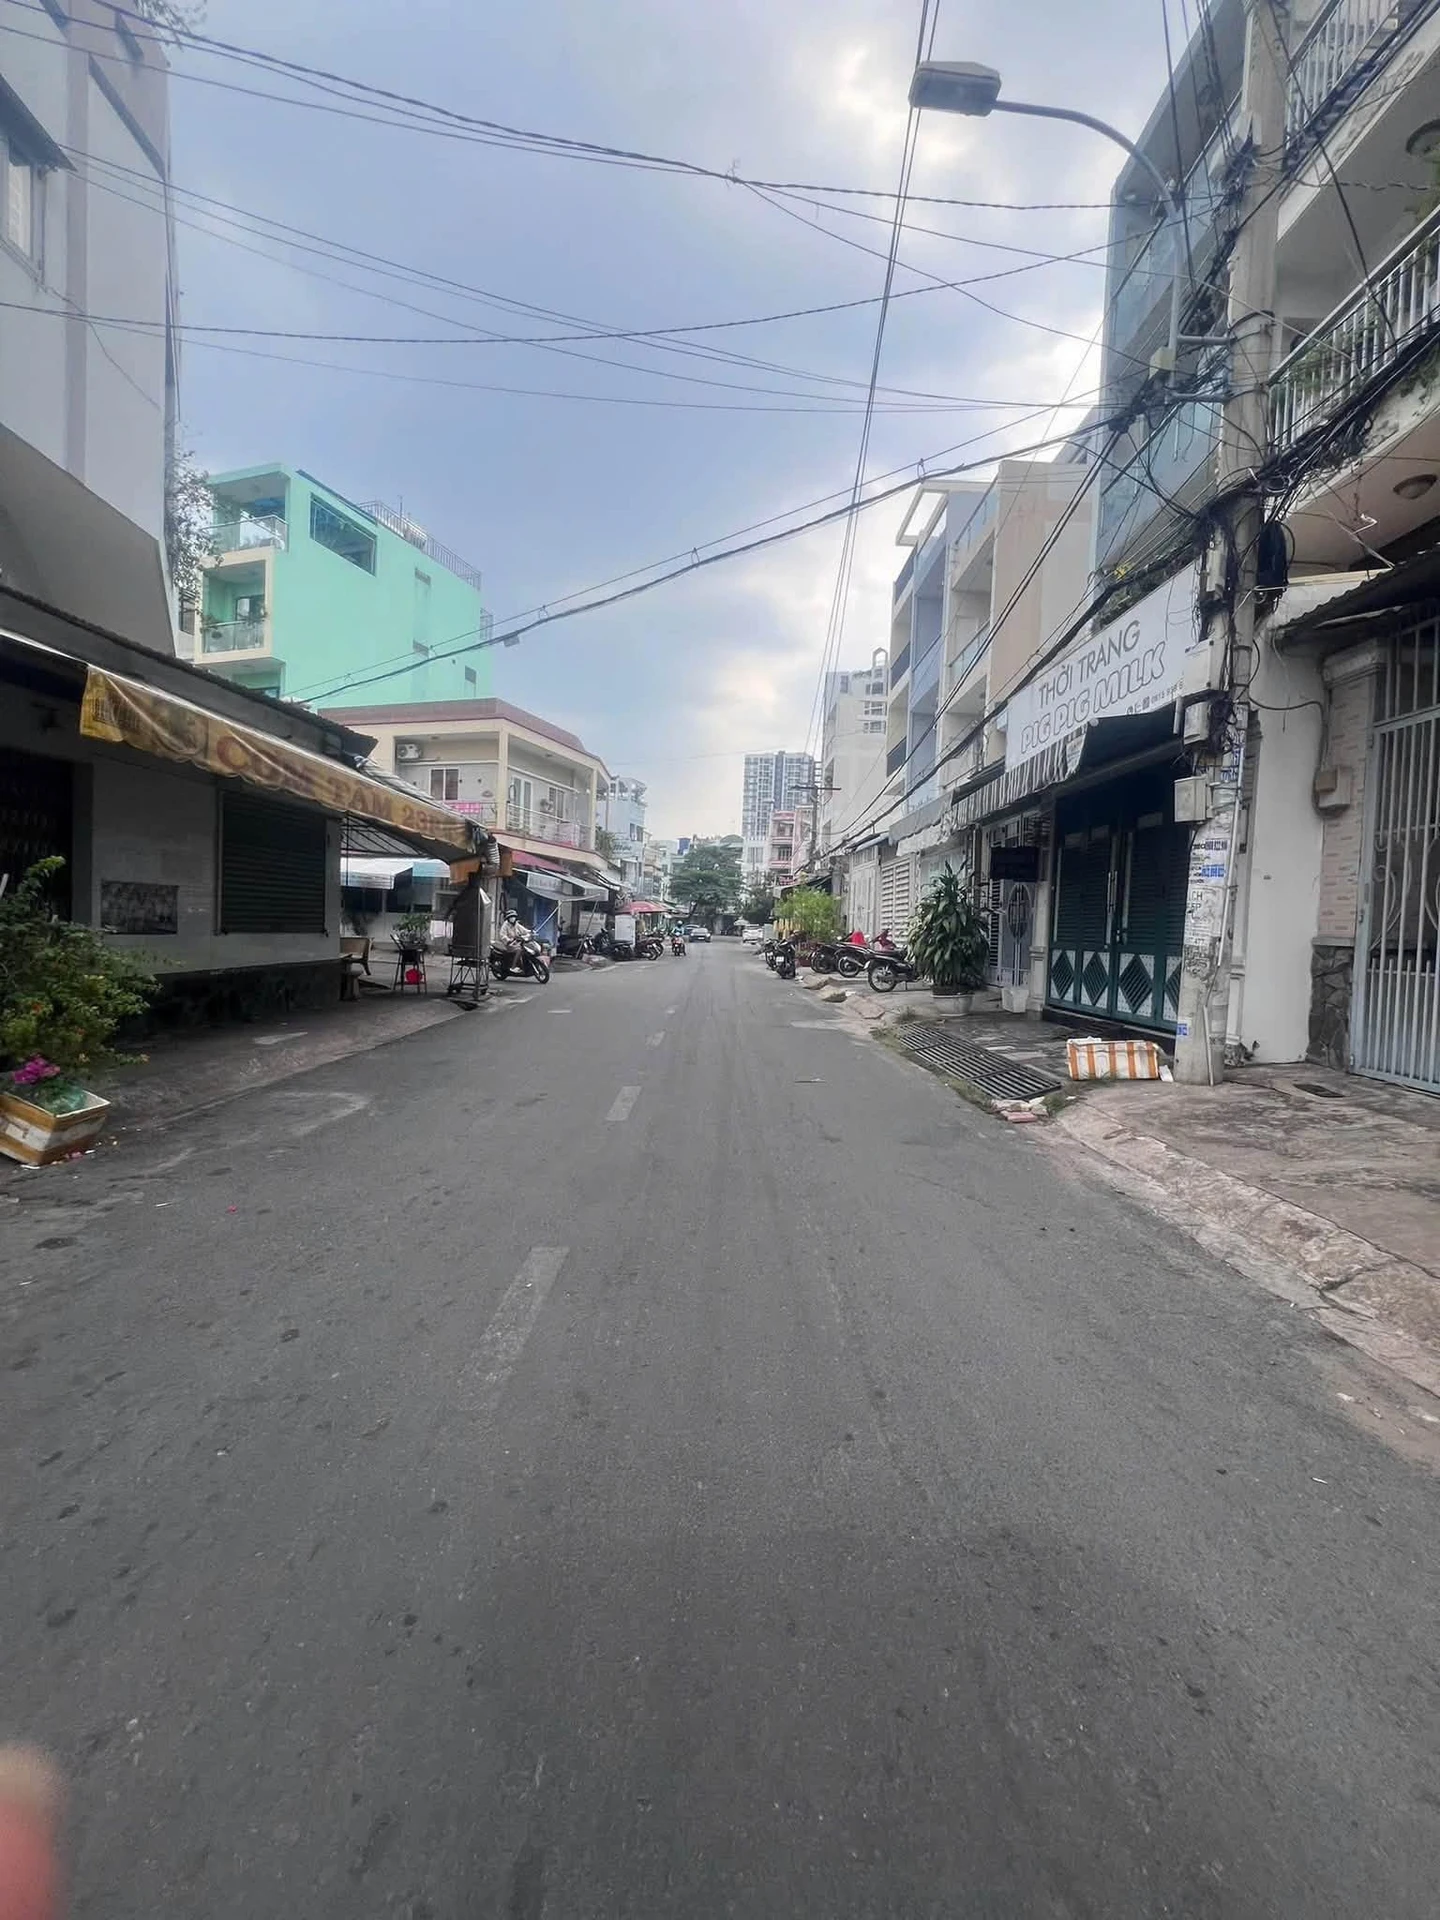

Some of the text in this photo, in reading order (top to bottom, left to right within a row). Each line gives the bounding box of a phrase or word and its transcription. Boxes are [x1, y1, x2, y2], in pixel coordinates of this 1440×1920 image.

[1038, 619, 1141, 708] THỜI TRANG
[1093, 640, 1166, 714] MILK
